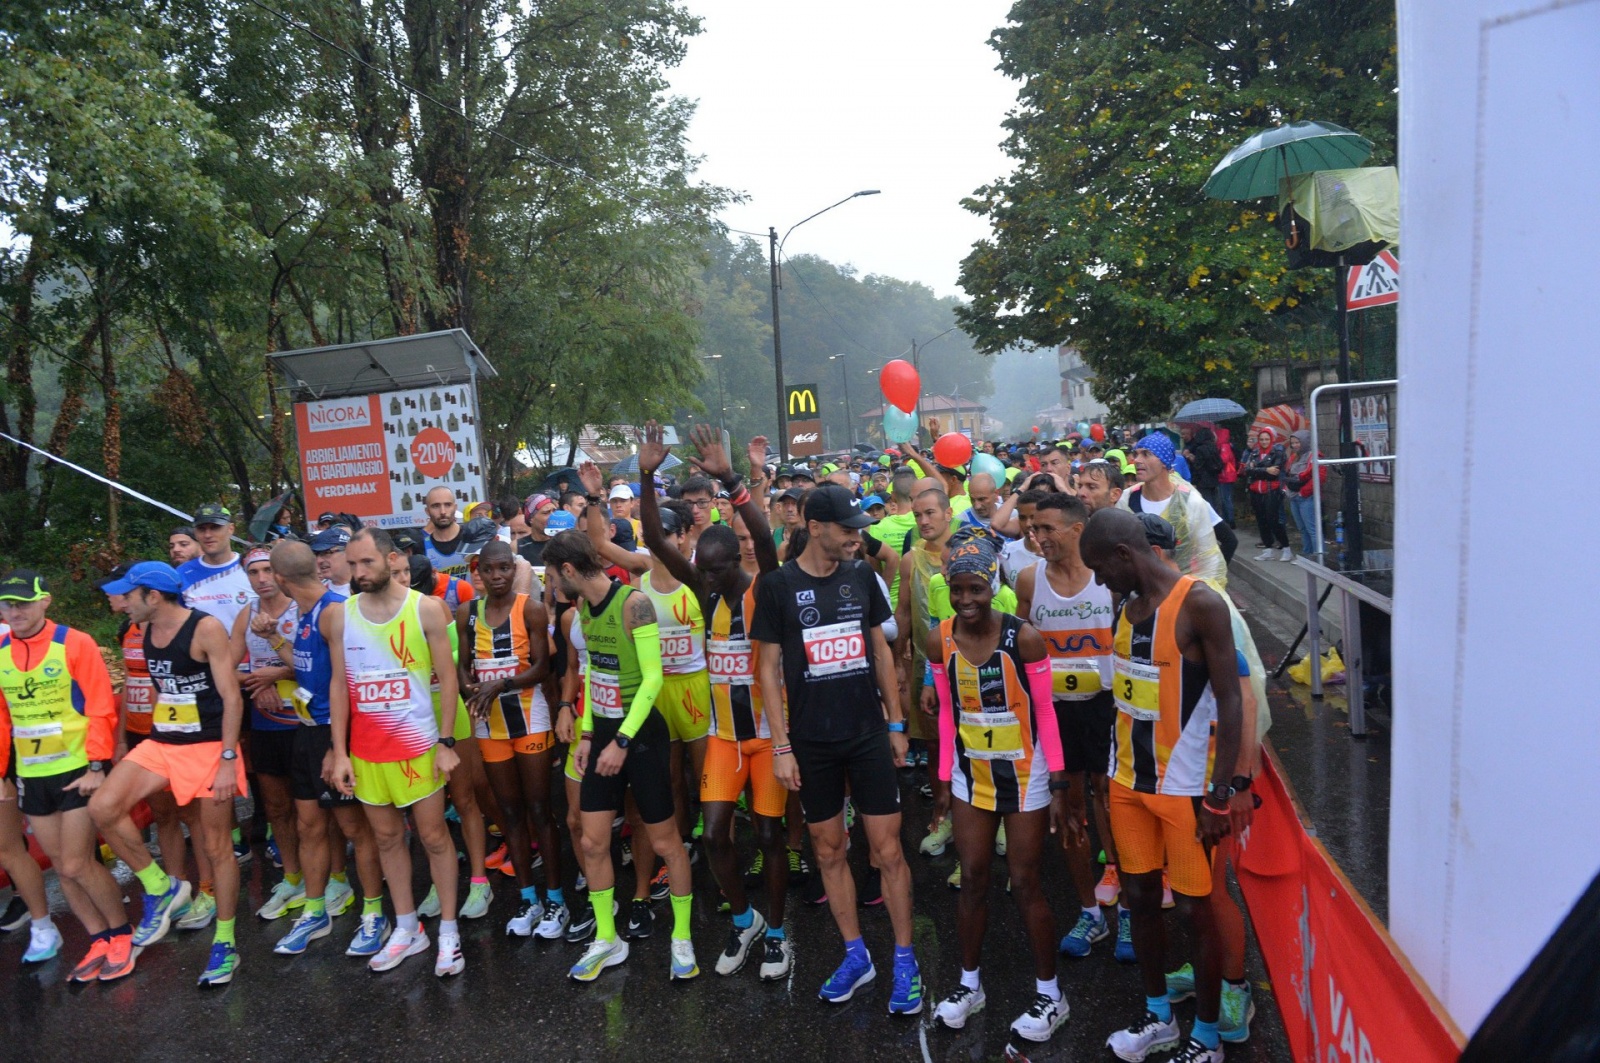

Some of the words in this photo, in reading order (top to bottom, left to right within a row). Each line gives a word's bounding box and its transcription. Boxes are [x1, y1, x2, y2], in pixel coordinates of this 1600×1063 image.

[305, 442, 382, 464] ABBIGLIAMENTO
[412, 441, 453, 465] -20%
[307, 466, 320, 481] DA
[321, 460, 384, 480] GIARDINAGGIO
[315, 482, 377, 498] VERDEMAX
[387, 516, 412, 526] VARESE
[1035, 605, 1075, 621] Green
[1079, 601, 1111, 620] Bar
[660, 638, 689, 655] 008
[810, 636, 862, 663] 1090
[708, 655, 749, 674] 1003
[357, 681, 406, 702] 1043
[1065, 674, 1078, 691] 9
[1123, 679, 1133, 701] 3
[168, 706, 177, 721] 2
[30, 738, 42, 755] 7
[983, 729, 994, 749] 1
